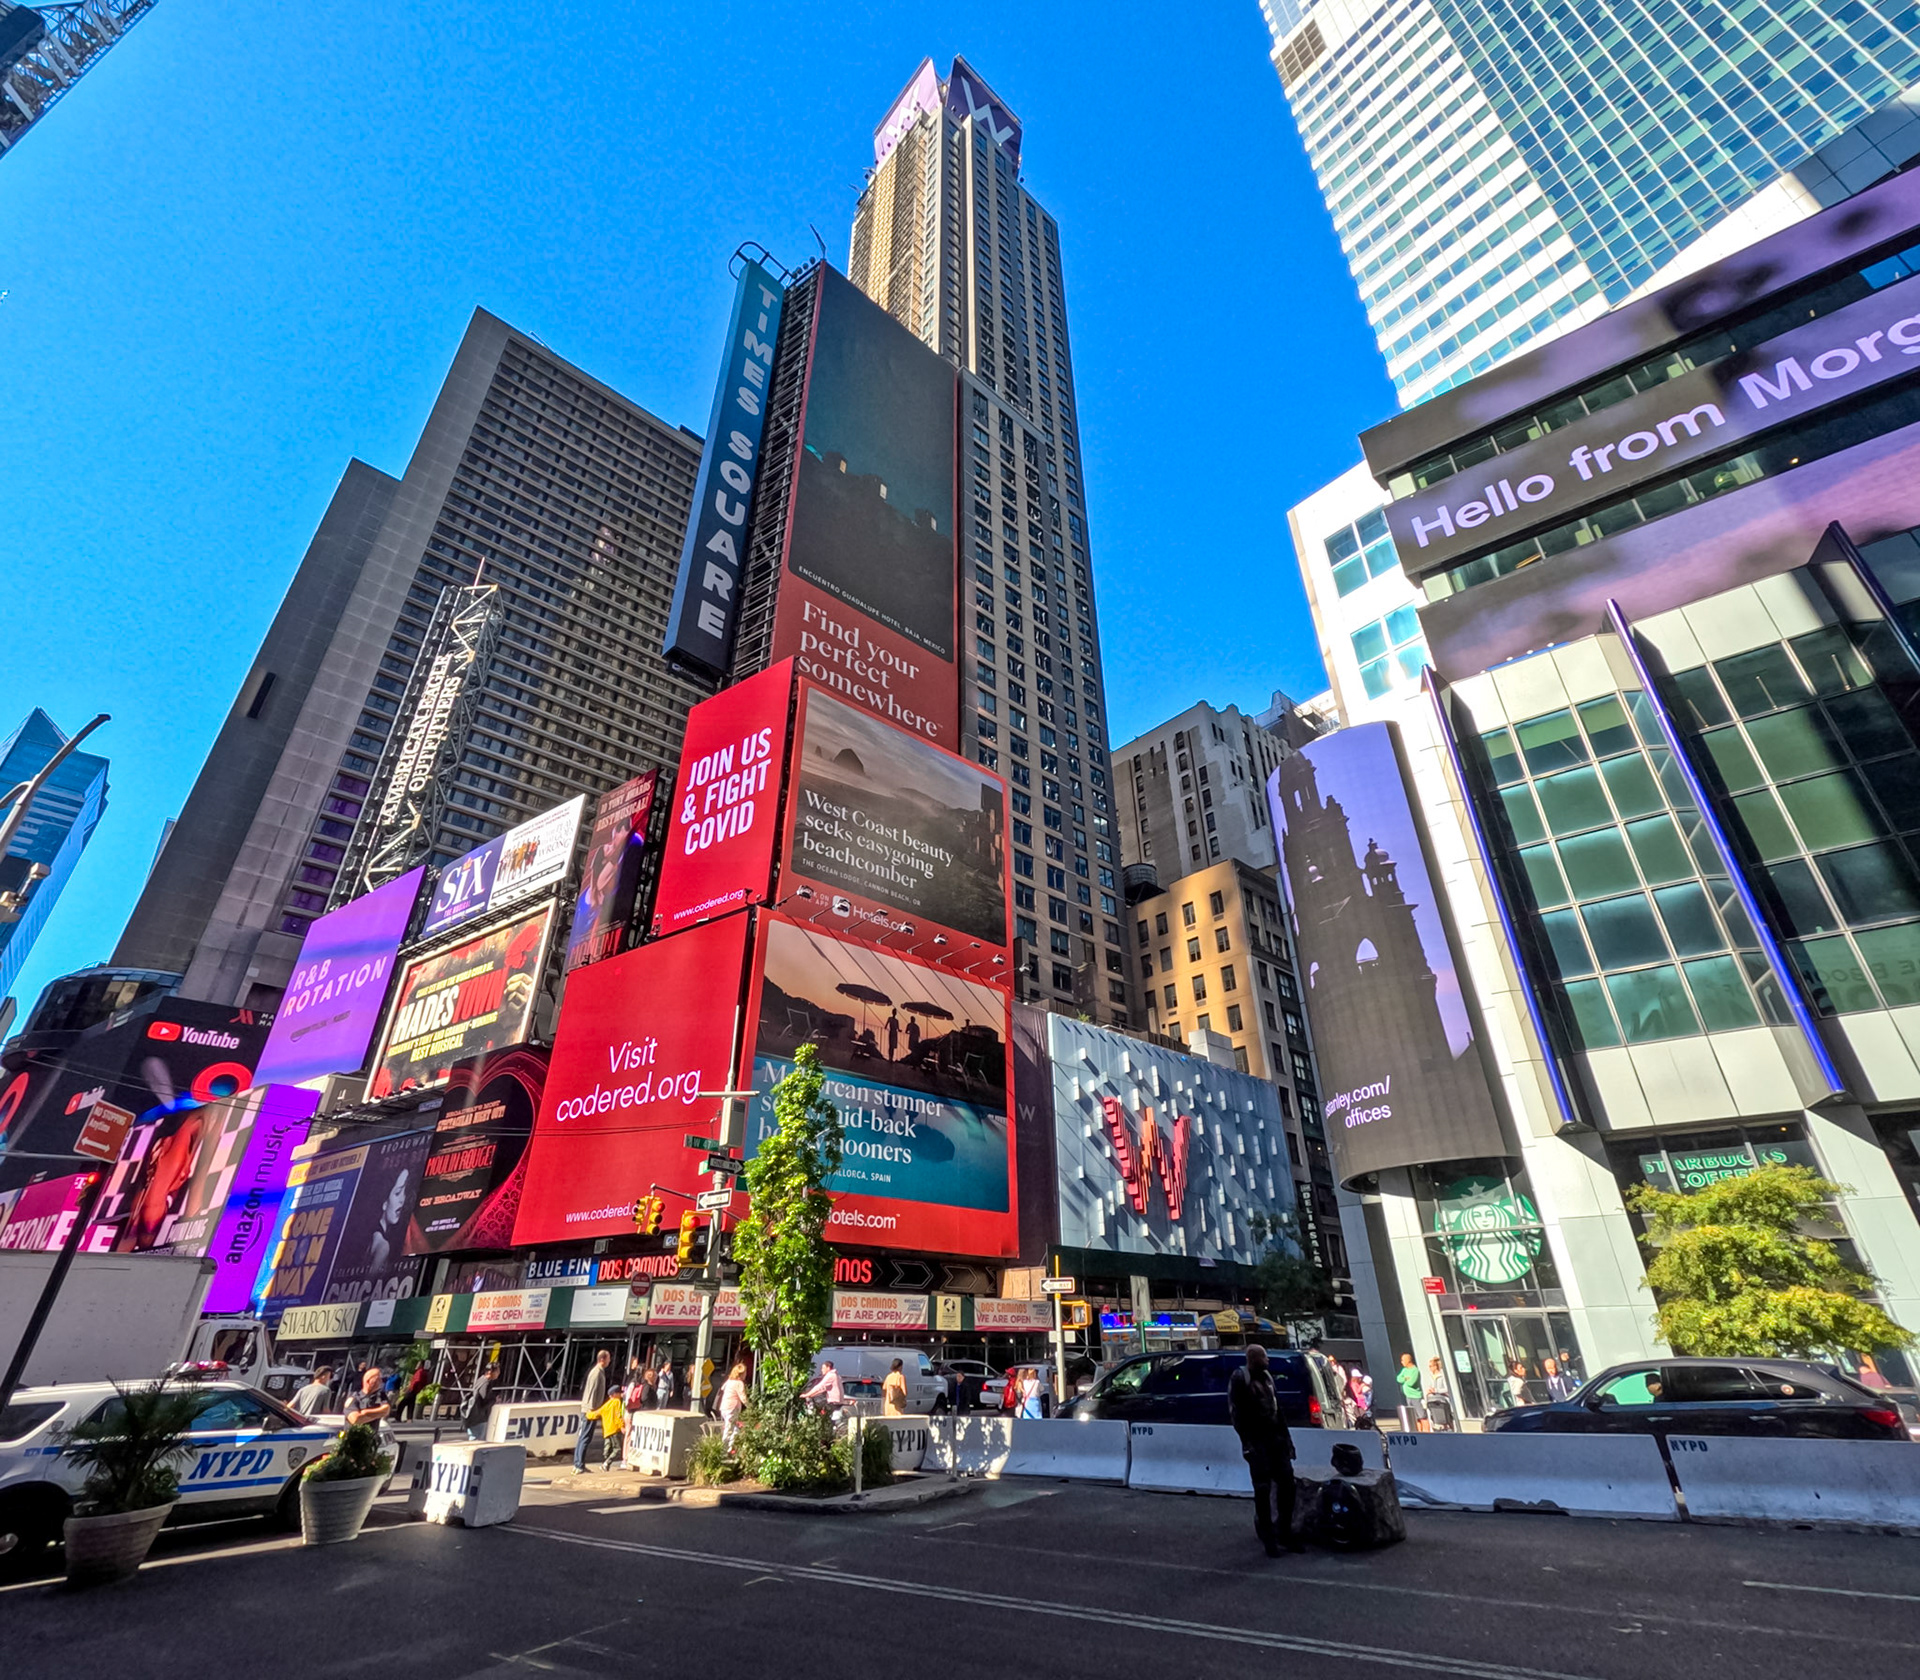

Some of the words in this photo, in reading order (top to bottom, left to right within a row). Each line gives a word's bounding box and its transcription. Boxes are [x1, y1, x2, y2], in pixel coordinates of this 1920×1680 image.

[736, 283, 778, 417] TIMES
[1411, 473, 1556, 549] Hello
[1569, 403, 1727, 481] from
[697, 430, 753, 640] SQUARE
[798, 565, 841, 594] ENCUENTRO
[841, 590, 880, 617] GUADALUPE
[923, 638, 946, 655] MEXICO
[802, 600, 860, 648] Find
[866, 640, 920, 680] your
[800, 630, 891, 689] perfect
[381, 712, 431, 825] AMERICAN
[420, 653, 453, 714] EAGLE
[409, 676, 462, 792] OUTFITTERS
[685, 744, 734, 792] JOIN
[740, 727, 772, 767] US
[680, 790, 697, 825] &
[704, 759, 771, 816] FIGHT
[683, 800, 754, 856] COVID
[805, 789, 848, 821] West
[852, 811, 900, 842] Coast
[902, 829, 954, 867] beauty
[803, 832, 918, 889] beachcomber
[805, 814, 853, 843] seeks
[856, 834, 935, 880] easygoing
[801, 858, 815, 868] THE
[816, 862, 839, 876] OCEAN
[863, 880, 889, 895] CANNON
[912, 898, 921, 906] OR
[673, 889, 744, 920] www.codered.org
[283, 956, 388, 1018] ROTATION
[292, 959, 332, 993] R&B
[391, 966, 510, 1046] HADESTOWN
[181, 1026, 240, 1050] YouTube
[410, 1043, 431, 1063] BEST
[429, 1032, 464, 1057] MUSICAL
[609, 1036, 658, 1074] Visit
[556, 1069, 701, 1122] codered.org
[874, 1087, 944, 1118] stunner
[94, 1106, 104, 1117] NO
[102, 1109, 127, 1126] STOPPING
[1018, 1103, 1036, 1123] W
[1345, 1104, 1392, 1129] offices
[254, 1124, 286, 1183] music
[381, 1133, 434, 1155] BROADWAY
[1103, 1096, 1192, 1221] W
[424, 1150, 460, 1178] MOULIN
[458, 1144, 497, 1171] ROUGE!
[1645, 1148, 1788, 1175] STARBUCKS
[870, 1172, 892, 1183] SPAIN
[419, 1197, 433, 1207] ON
[432, 1189, 483, 1205] BROADWAY
[225, 1187, 265, 1265] amazon
[282, 1207, 335, 1240] COME
[528, 1259, 562, 1278] BLUE
[567, 1257, 592, 1275] FIN
[598, 1259, 623, 1281] DOS
[625, 1254, 679, 1279] CAMINOS
[324, 1276, 414, 1303] CHICAGO
[477, 1296, 490, 1310] DOS
[492, 1294, 522, 1308] CAMINOS
[663, 1289, 685, 1303] DOS
[841, 1296, 858, 1308] DOS
[861, 1297, 898, 1309] CAMINOS
[279, 1306, 359, 1336] SWAROVSKI
[472, 1311, 483, 1322] WE
[485, 1310, 501, 1321] ARE
[502, 1309, 524, 1320] OPEN
[655, 1304, 675, 1316] WE
[679, 1304, 702, 1316] ARE
[712, 1305, 741, 1317] OPEN
[835, 1310, 851, 1319] WE
[854, 1310, 874, 1320] ARE
[877, 1311, 902, 1320] OPEN
[977, 1314, 989, 1323] WE
[992, 1314, 1008, 1323] ARE
[1010, 1315, 1031, 1324] OPEN
[981, 1302, 994, 1313] DOS
[997, 1303, 1027, 1313] CAMINOS
[517, 1414, 580, 1438] NYPD
[633, 1426, 665, 1452] NYPD
[1131, 1426, 1154, 1436] NYPD
[1389, 1435, 1418, 1447] NYPD
[1670, 1440, 1708, 1452] NYPD
[188, 1448, 275, 1480] NYPD
